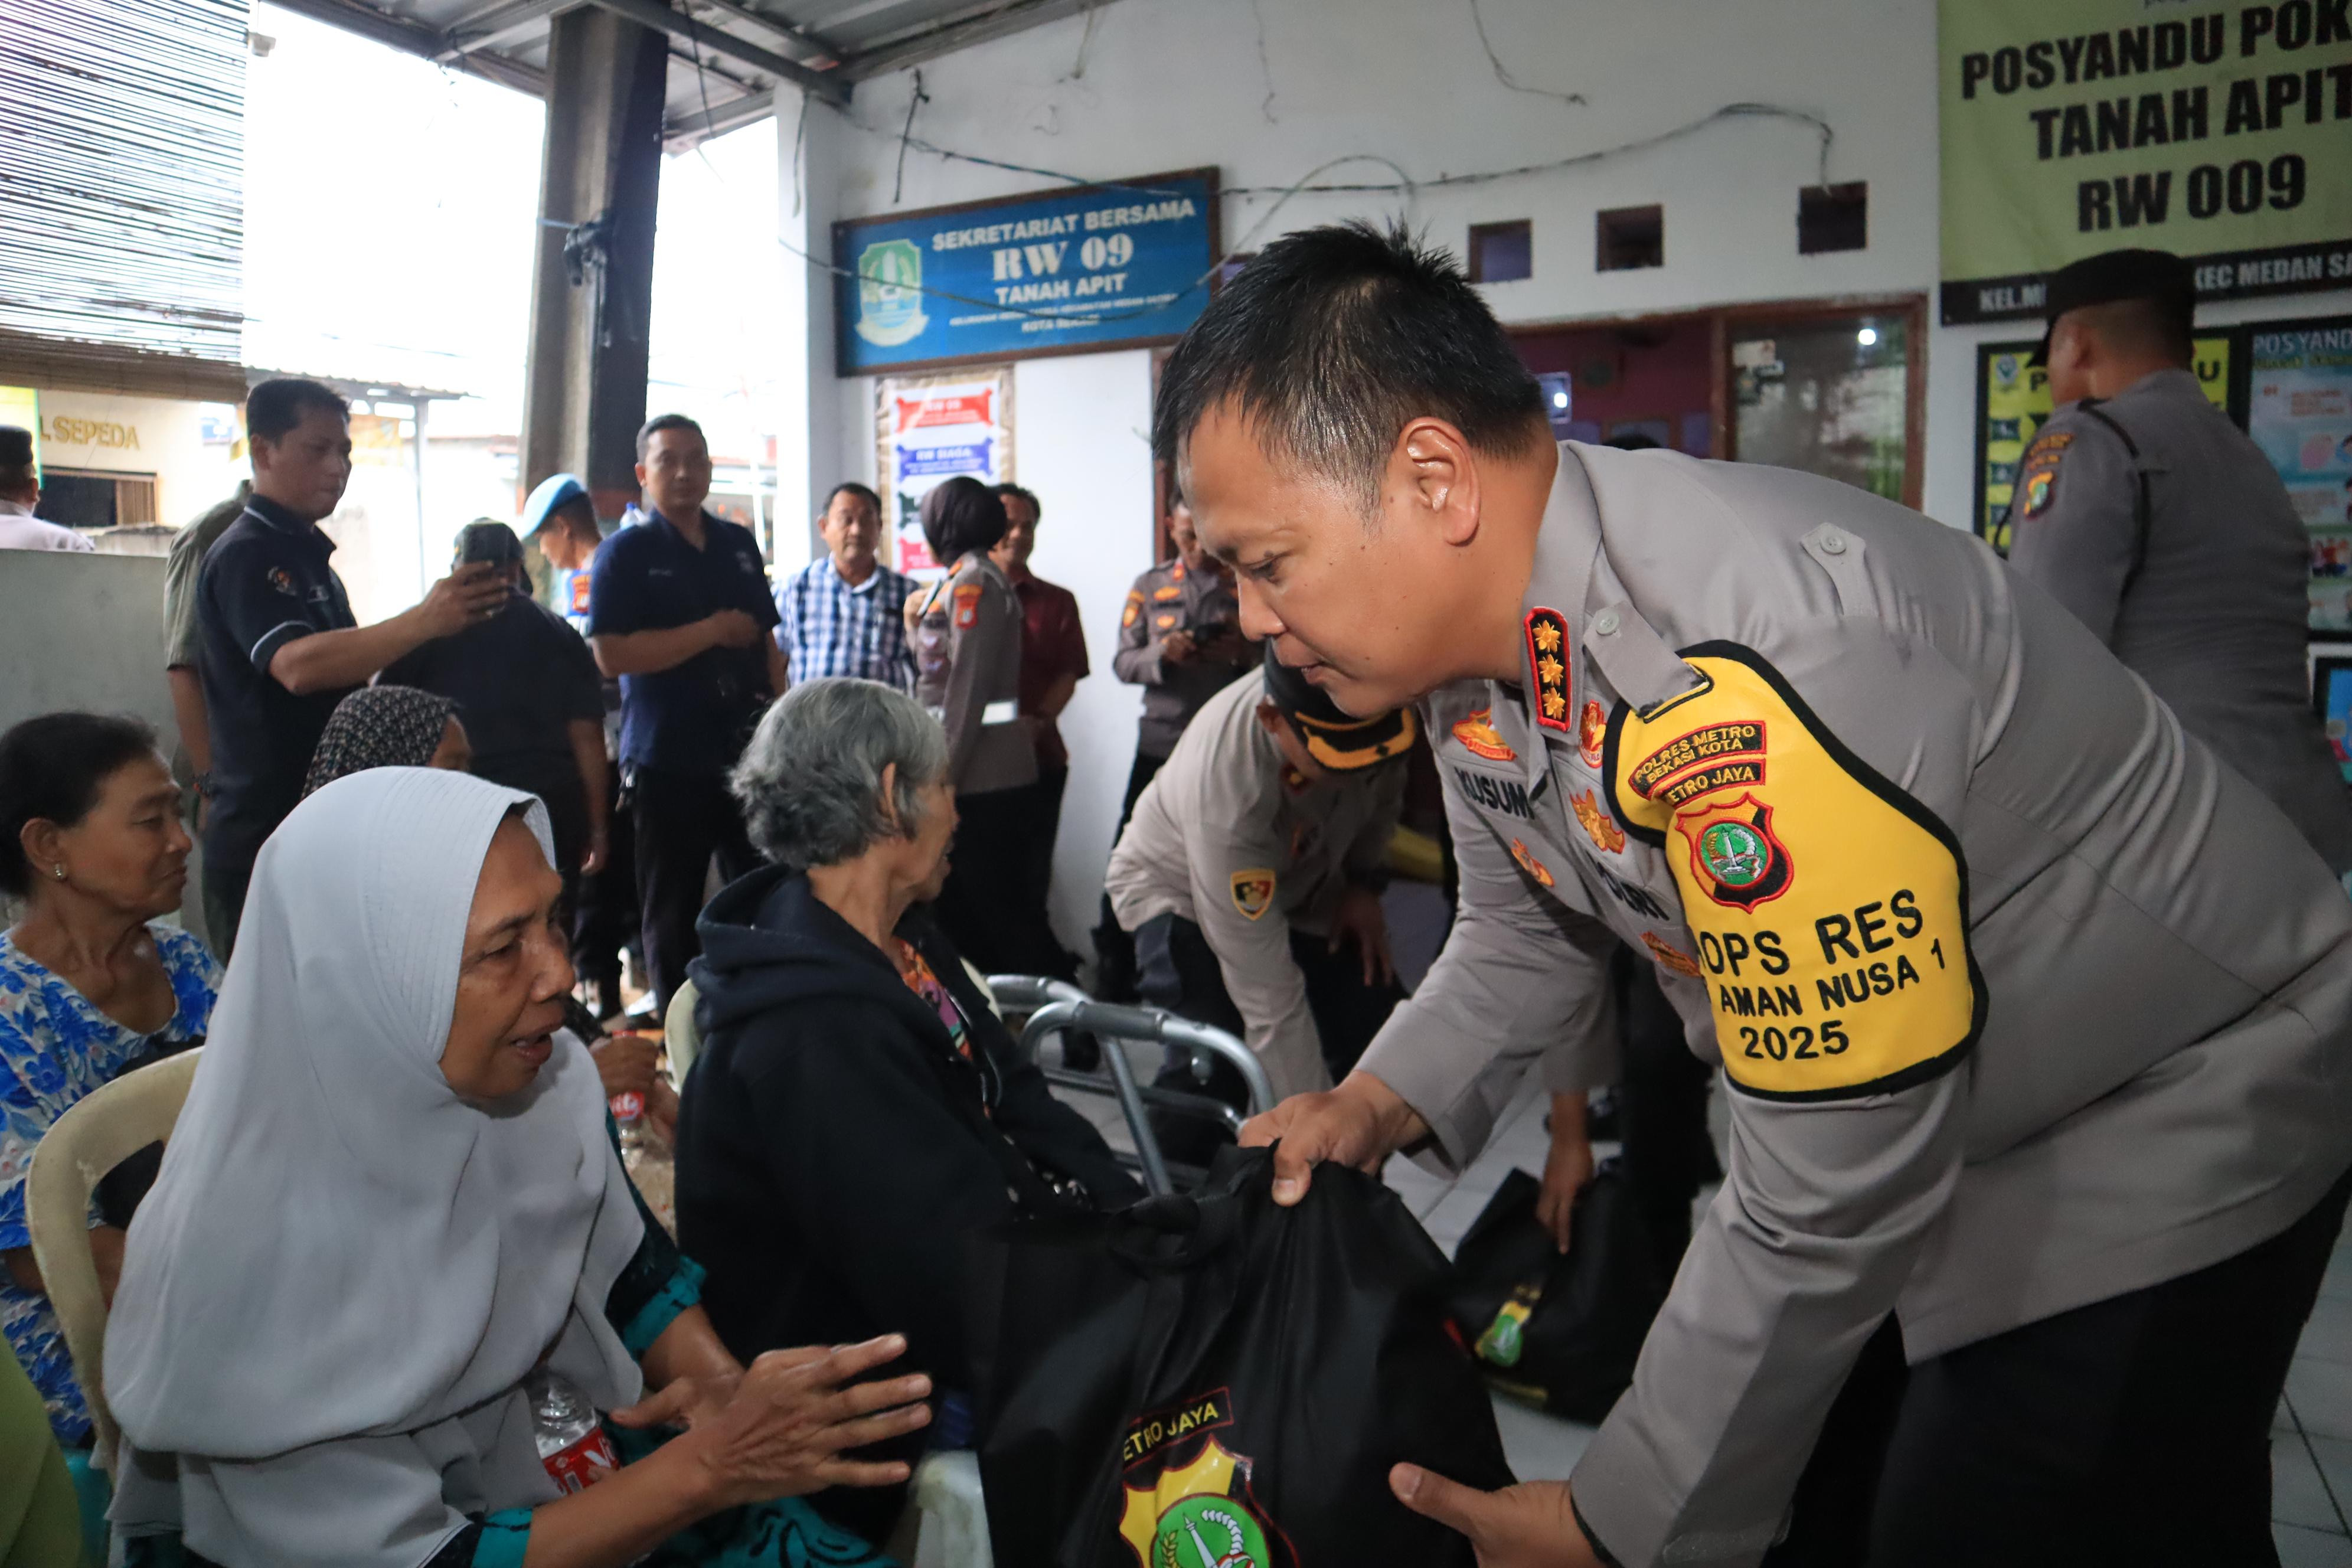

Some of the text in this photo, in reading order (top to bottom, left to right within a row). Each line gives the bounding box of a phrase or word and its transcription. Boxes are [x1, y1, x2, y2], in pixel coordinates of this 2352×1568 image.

[1962, 0, 2352, 99] POSYANDU POK
[2030, 63, 2352, 161] TANAH APIT
[2077, 154, 2306, 233] RW 009
[933, 198, 1196, 251] SEKRETARIAT BERSAMA
[992, 232, 1134, 282] RW 09
[1979, 283, 2047, 312] KEL.M
[2237, 254, 2324, 286] MEDAN
[995, 277, 1072, 306] TANAH
[1075, 273, 1128, 296] APIT
[52, 416, 141, 451] SEPEDA
[1634, 739, 1690, 784] POLRES
[1691, 724, 1756, 747] METRO
[1646, 739, 1743, 784] BEKASI KOTA
[1454, 766, 1536, 821] KUSUM
[1664, 765, 1756, 806] ETRO JAYA
[1700, 888, 1925, 977] OPS RES
[1719, 937, 1946, 1018] AMAN NUSA 1
[1739, 1019, 1850, 1062] 2025
[1122, 1400, 1219, 1462] ETRO JAYA
